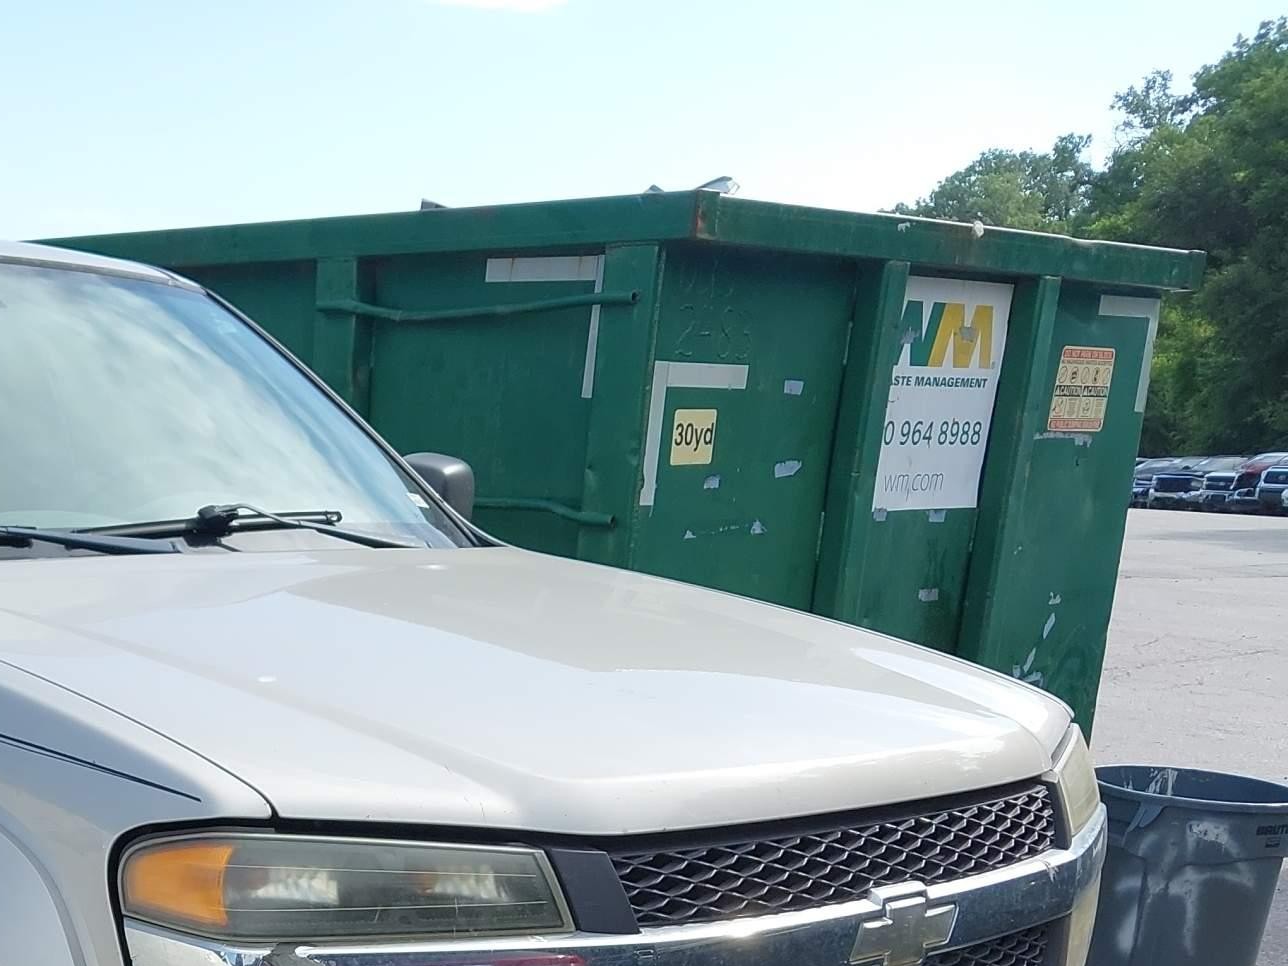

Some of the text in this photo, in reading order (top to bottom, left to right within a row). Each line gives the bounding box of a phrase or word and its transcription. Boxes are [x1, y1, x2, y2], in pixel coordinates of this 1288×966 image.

[893, 375, 988, 388] STE MANAGEMENT
[675, 422, 714, 452] 30yd
[899, 420, 934, 446] 964
[937, 420, 982, 446] 8988
[884, 472, 944, 493] wm.com
[1255, 823, 1288, 836] BRUT
